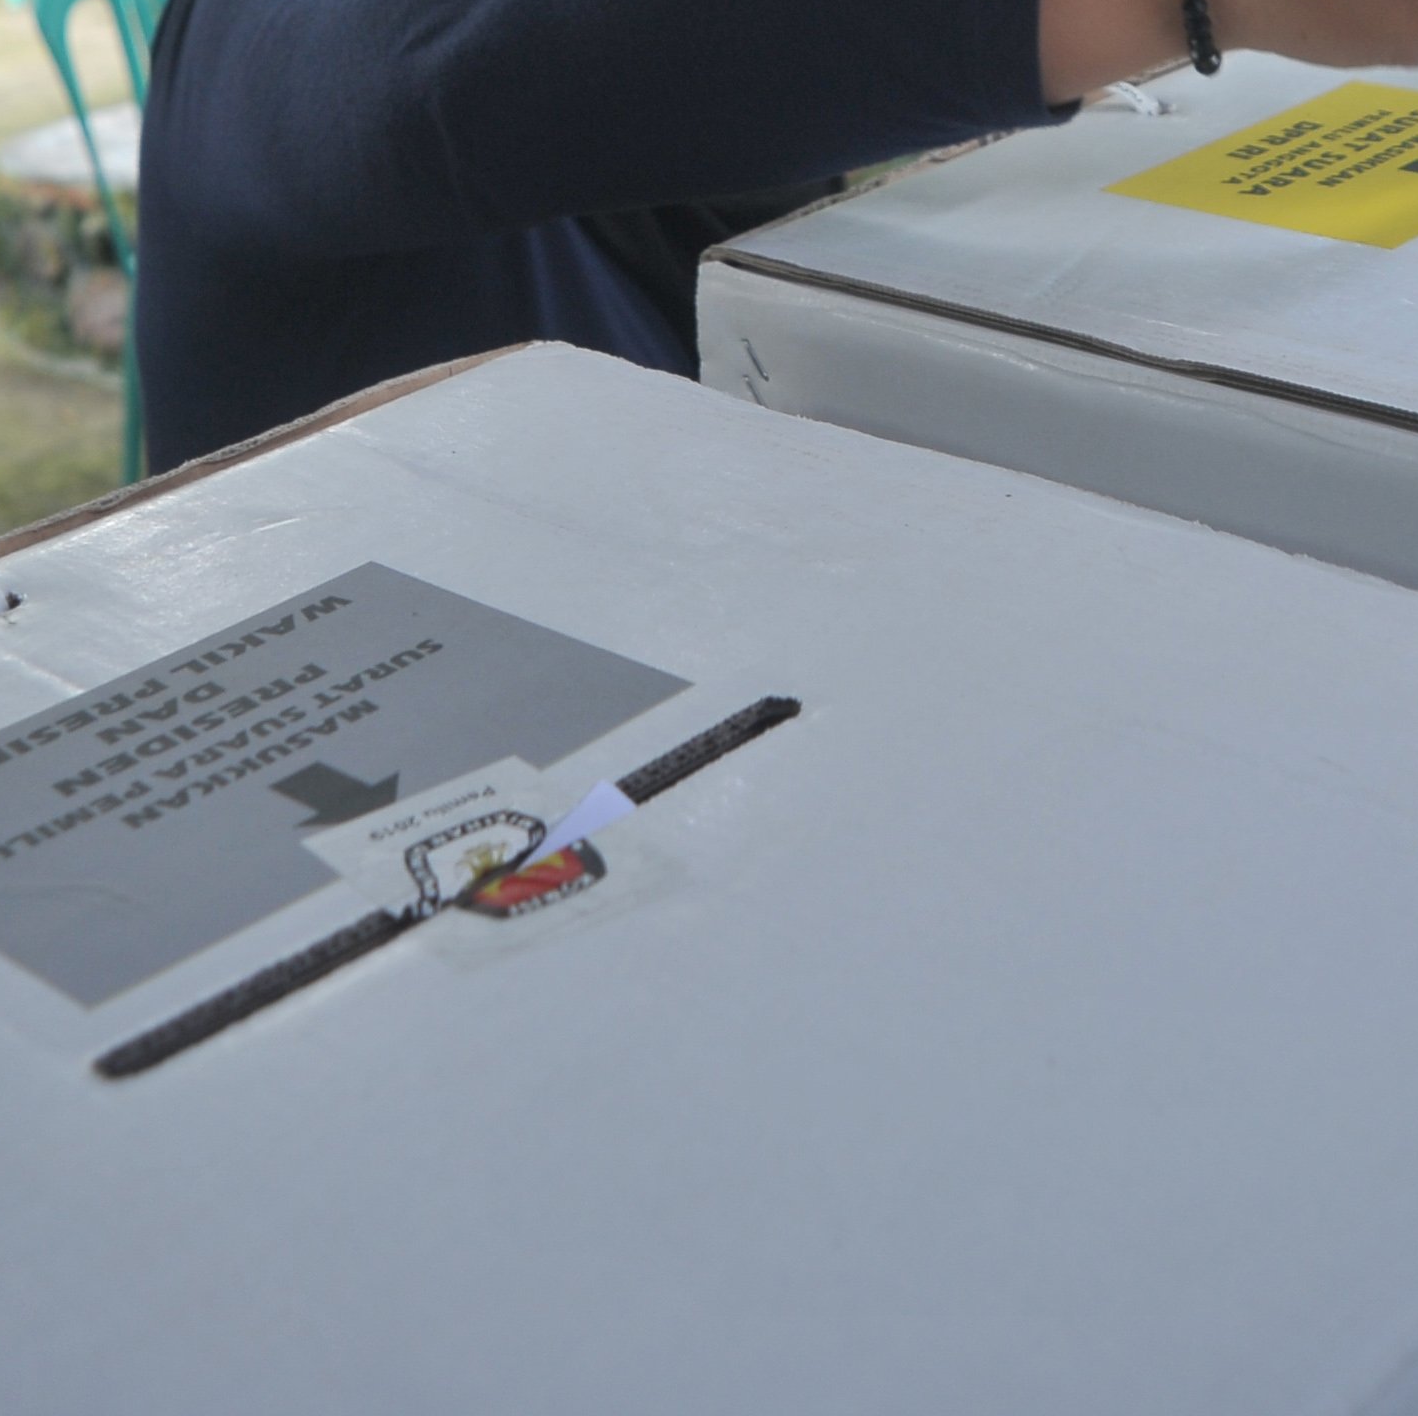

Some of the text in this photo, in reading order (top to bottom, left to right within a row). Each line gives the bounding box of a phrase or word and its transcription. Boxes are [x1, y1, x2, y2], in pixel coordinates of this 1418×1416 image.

[1221, 109, 1392, 185] PEMILU ANGGOTA
[1226, 120, 1324, 160] DPR RI
[1237, 151, 1347, 196] SUARA
[169, 595, 353, 675] WAKIL
[312, 638, 444, 710] SURAT
[52, 663, 327, 798] PRESIDEN
[96, 680, 226, 746] DAN
[152, 705, 307, 779] SUARA
[122, 698, 380, 828] MASUKKAN
